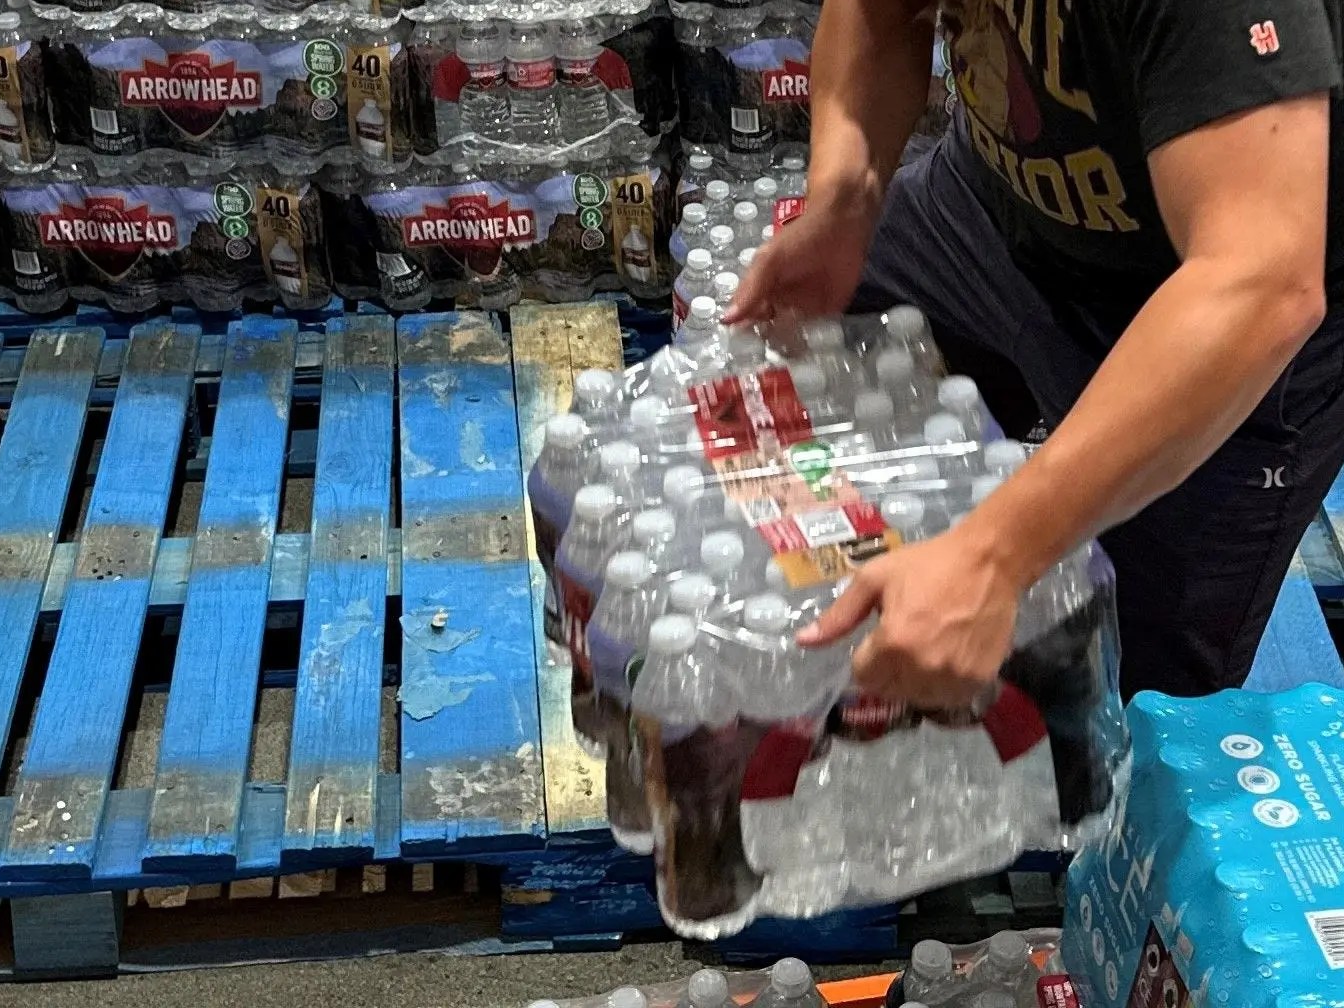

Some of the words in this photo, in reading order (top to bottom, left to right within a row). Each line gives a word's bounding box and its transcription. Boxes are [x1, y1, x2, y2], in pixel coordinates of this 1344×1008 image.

[351, 55, 381, 76] 40
[127, 75, 258, 102] ARROWHEAD
[615, 181, 645, 205] 40
[261, 195, 291, 218] 40
[45, 219, 173, 244] ARROWHEAD
[408, 215, 531, 242] ARROWHEAD
[1272, 733, 1304, 771] ZERO
[1294, 772, 1332, 822] SUGAR
